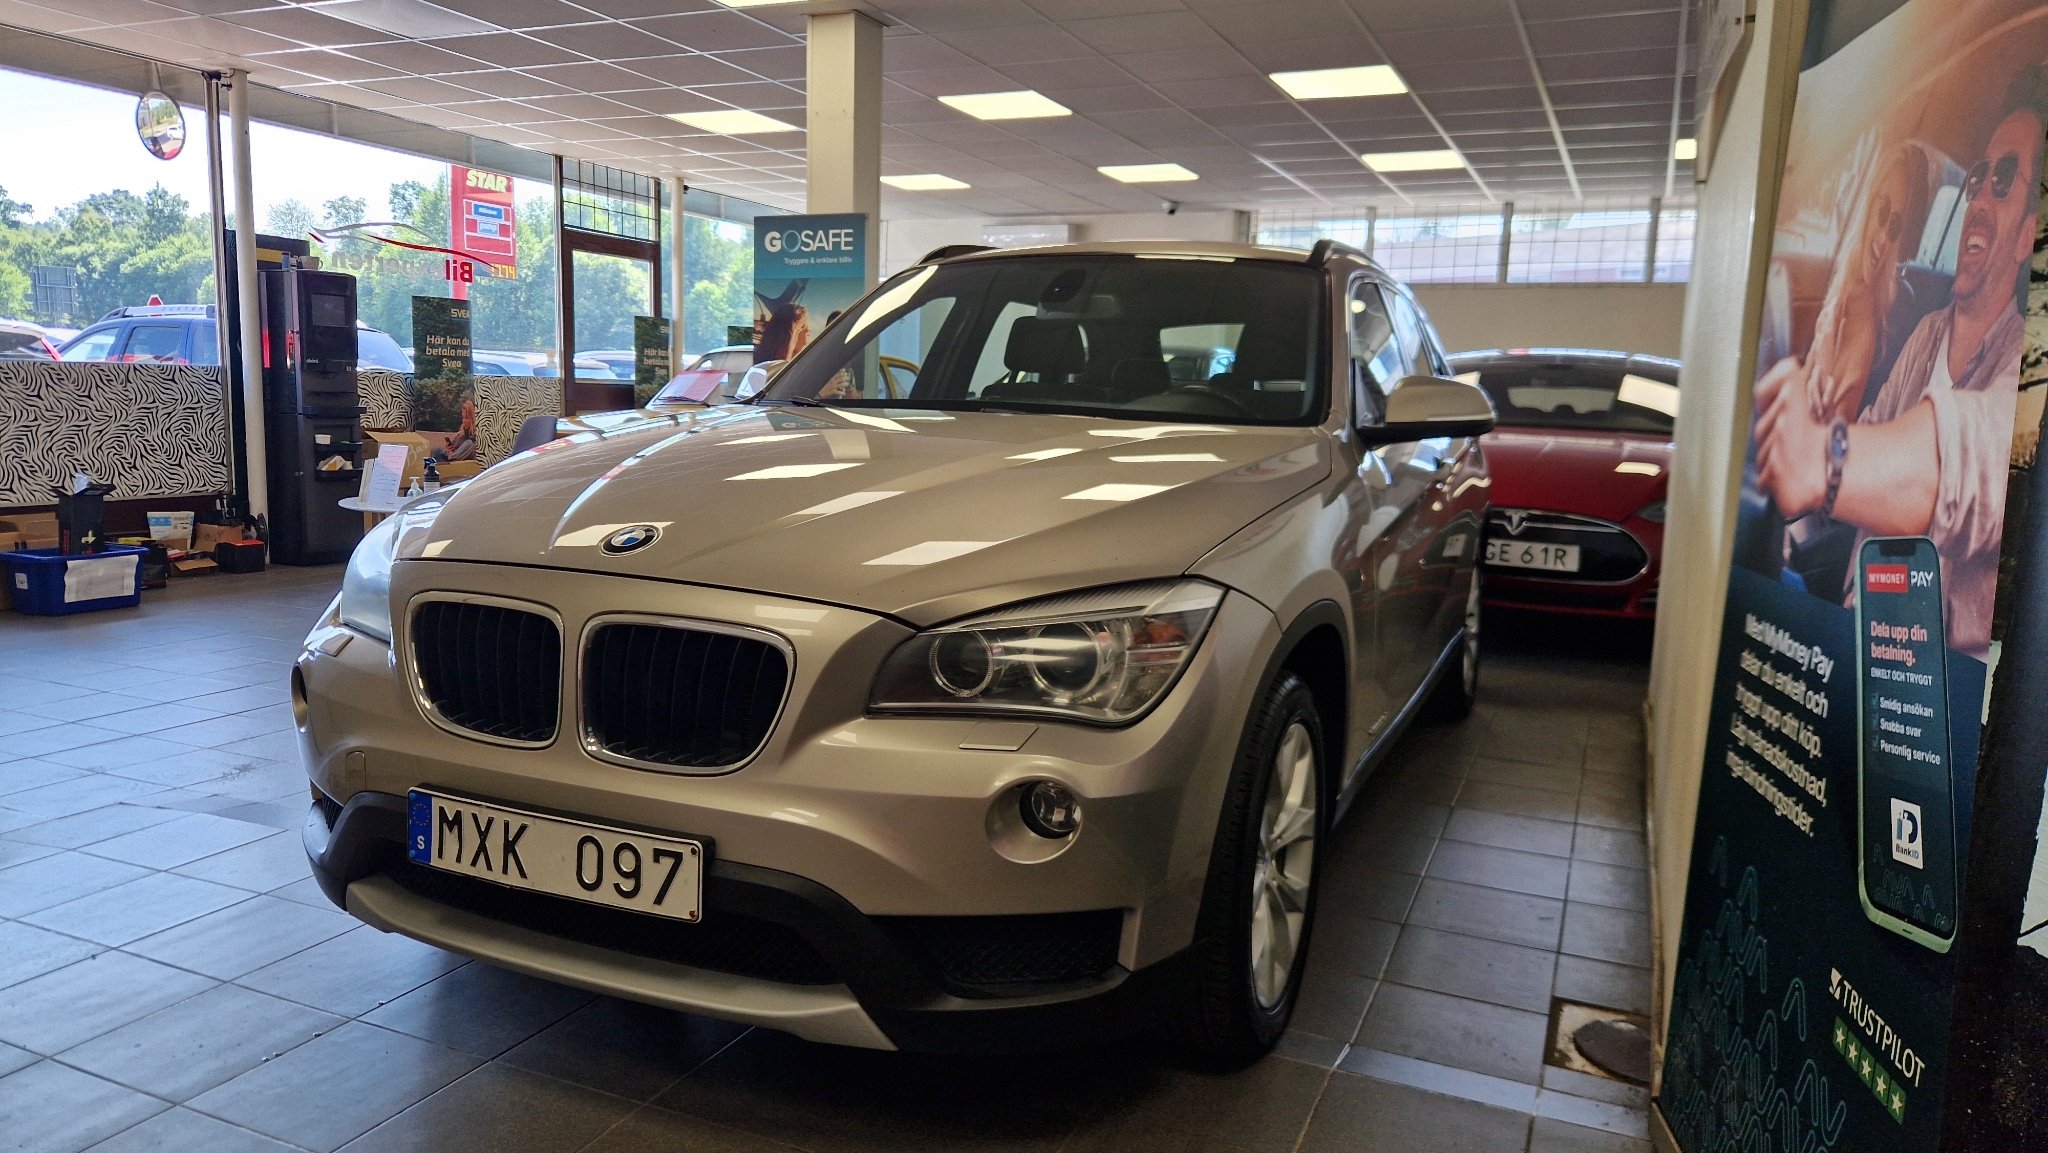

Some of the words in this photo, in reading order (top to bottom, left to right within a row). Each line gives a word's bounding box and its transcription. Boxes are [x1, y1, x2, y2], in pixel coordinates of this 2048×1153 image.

[466, 169, 508, 193] STAR
[764, 229, 854, 253] GOSAFE
[784, 257, 809, 265] Tryggare
[450, 308, 470, 318] SVEA
[426, 334, 445, 344] Här
[446, 335, 461, 345] kan
[462, 336, 470, 345] du
[426, 346, 456, 356] betala
[456, 348, 470, 357] med
[442, 358, 461, 367] Svea
[1521, 545, 1567, 568] 61R
[1868, 572, 1906, 585] MYMONEY
[1910, 571, 1933, 588] PAY
[1870, 621, 1891, 638] Dela
[1891, 625, 1909, 643] upp
[1910, 624, 1928, 642] din
[1810, 645, 1834, 684] Pay
[1870, 642, 1916, 667] betalning.
[1870, 666, 1891, 680] ENKELT
[1892, 670, 1905, 682] OCH
[1906, 674, 1933, 687] TRYGGT
[1805, 689, 1829, 719] och
[1879, 696, 1902, 716] Smidig
[1902, 701, 1934, 718] ansökan
[1880, 717, 1904, 735] Snabba
[1905, 725, 1922, 738] svar
[1799, 722, 1822, 759] köp.
[1880, 739, 1912, 761] Personlig
[1912, 748, 1941, 766] service
[417, 835, 425, 850] S
[1895, 843, 1920, 860] BankID
[437, 805, 530, 879] MXK
[575, 834, 685, 906] 097
[1842, 979, 1926, 1088] TRUSTPILOT
